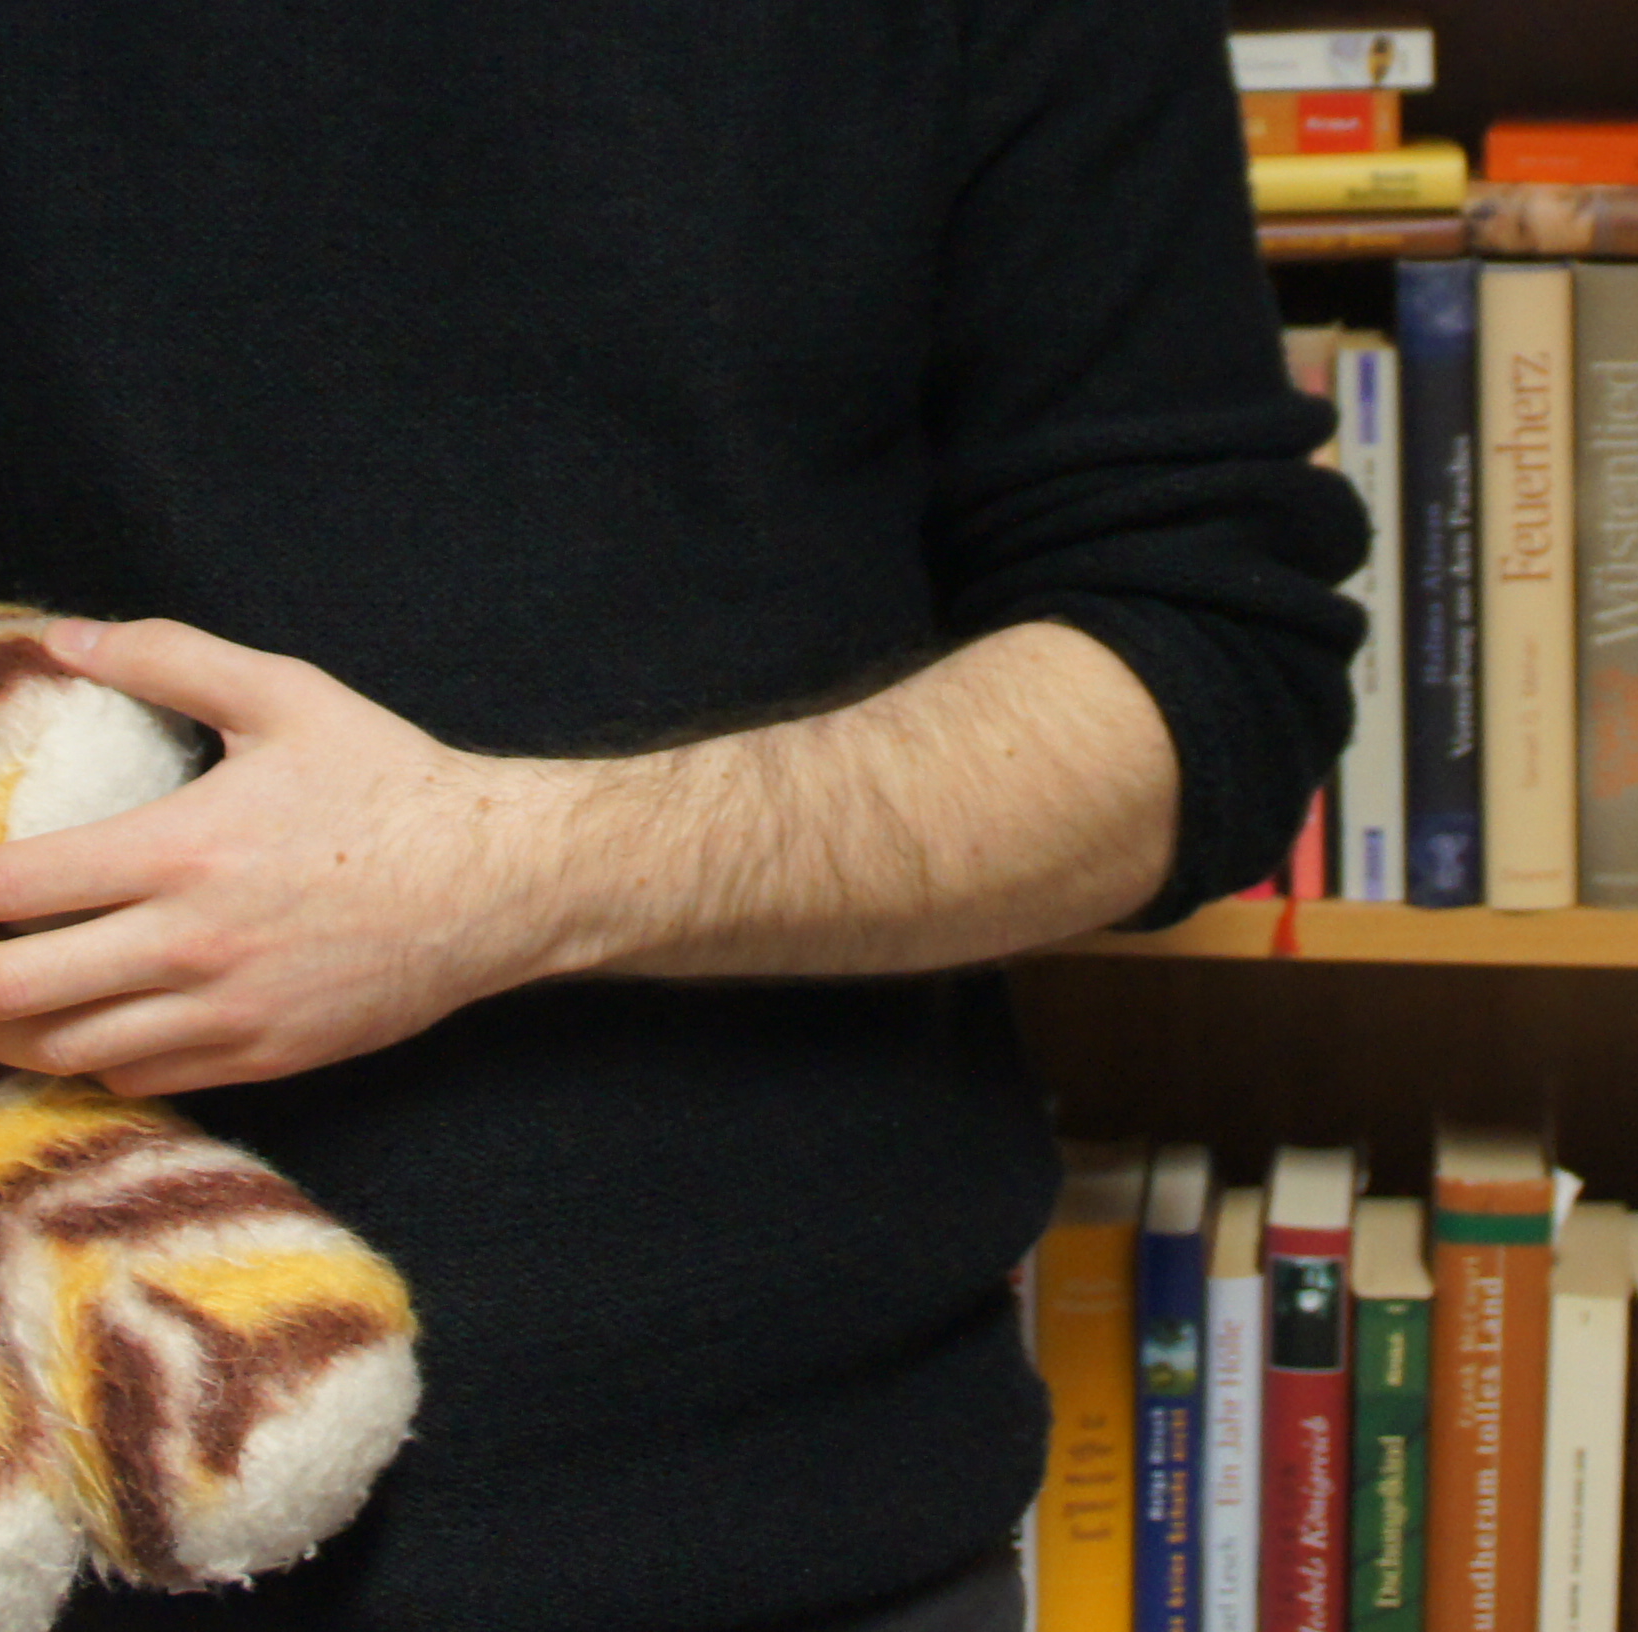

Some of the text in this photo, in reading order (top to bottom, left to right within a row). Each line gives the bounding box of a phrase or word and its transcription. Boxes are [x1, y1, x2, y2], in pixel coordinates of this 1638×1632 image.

[1494, 351, 1554, 586] Feuerherz
[1479, 1276, 1504, 1353] Land
[1213, 1318, 1243, 1388] Hölle
[1213, 1398, 1243, 1451] Jahr
[1476, 1364, 1500, 1455] tolles
[1214, 1464, 1242, 1508] Ein
